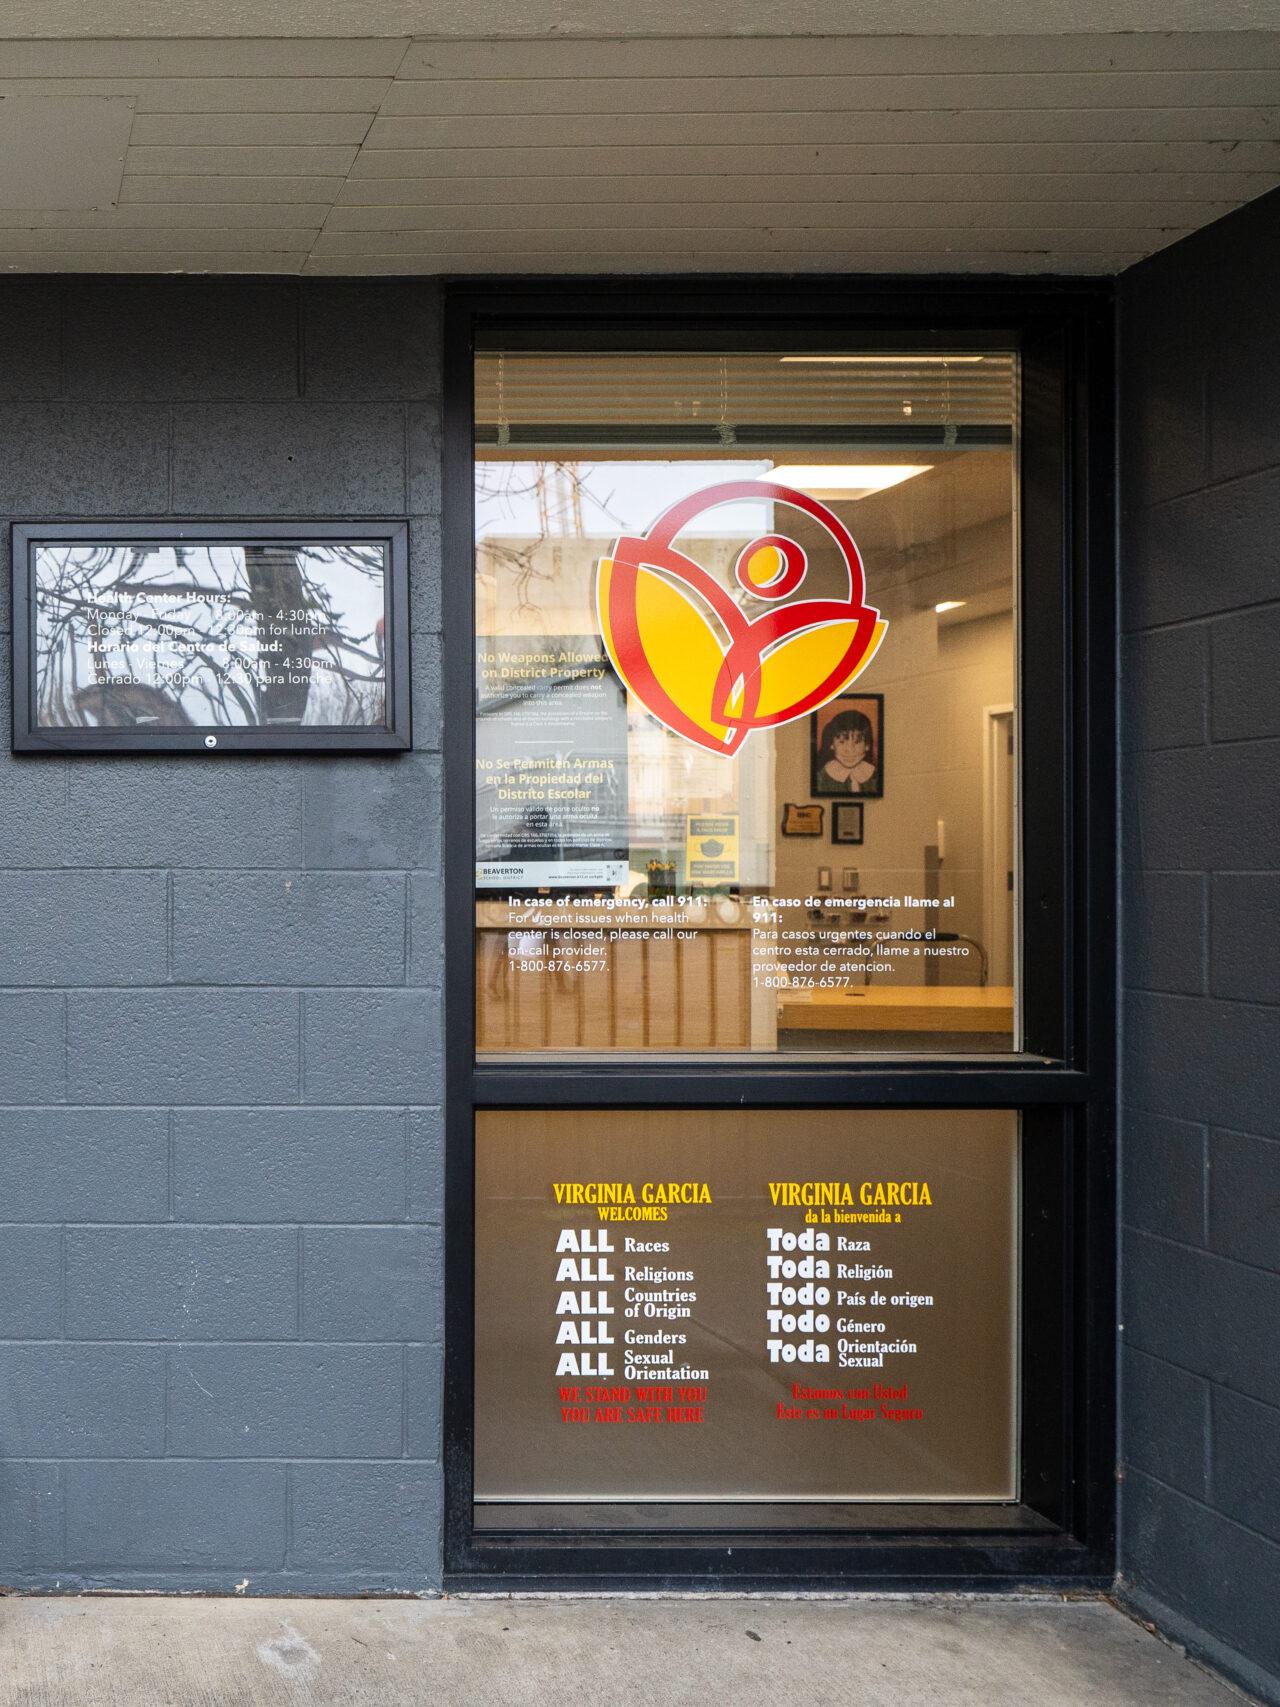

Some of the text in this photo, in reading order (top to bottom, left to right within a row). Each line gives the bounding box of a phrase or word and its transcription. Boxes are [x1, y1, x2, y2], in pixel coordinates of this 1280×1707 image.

[88, 592, 231, 604] Health Center Hours:
[87, 609, 139, 622] Monday
[87, 624, 132, 636] Closed
[269, 623, 287, 635] for
[291, 623, 326, 635] lunch
[88, 640, 283, 653] Horario del Centro de Salud:
[282, 657, 333, 670] 4:30pm
[478, 653, 495, 663] No
[498, 653, 555, 665] Weapons
[87, 673, 140, 685] Cerrado
[256, 675, 285, 687] para
[481, 667, 605, 681] on District Property
[476, 758, 614, 769] No Se Permiten Armas
[486, 773, 603, 786] en la Propiedad del
[498, 788, 592, 800] Distrito Escolar
[508, 895, 708, 910] In case of emergency, call 911:
[752, 896, 955, 910] En caso de emergencia llame al
[508, 912, 689, 926] For urgent issues when health
[752, 912, 783, 924] 911:
[508, 928, 698, 942] center is closed, please call our
[753, 928, 936, 943] Para casos urgentes cuando el
[508, 944, 608, 958] on-call provider.
[752, 944, 969, 957] centro esta cerrado, llame a nuestro
[509, 960, 610, 972] 1-800-876-6577.
[752, 960, 895, 975] proveedor de atencion.
[753, 976, 854, 988] 1-800-876-6577.
[553, 1183, 712, 1204] VIRGINIA GARCIA
[769, 1182, 933, 1206] VIRGINIA GARCIA
[598, 1206, 668, 1221] WELCOMES
[805, 1209, 902, 1224] da la bienvenida a
[555, 1229, 670, 1253] ALL Races
[767, 1228, 871, 1251] Toda Raza
[555, 1258, 694, 1283] ALL Religions
[767, 1255, 893, 1281] Toda Religión
[555, 1287, 697, 1315] ALL Countries
[767, 1282, 934, 1308] Todo País de origen
[624, 1303, 691, 1320] of Origin
[767, 1309, 886, 1333] Todo Género
[555, 1321, 687, 1345] ALL Genders
[767, 1338, 917, 1363] Toda Orientación
[555, 1350, 673, 1376] ALL Sexual
[838, 1353, 884, 1368] Sexual
[624, 1365, 709, 1380] Orientation
[559, 1386, 708, 1403] WE STAND WITH YOU
[792, 1382, 908, 1400] Estamos con Usted
[561, 1407, 705, 1424] YOU ARE SAFE HERE
[776, 1402, 923, 1422] Este es un Lugar Seguro
